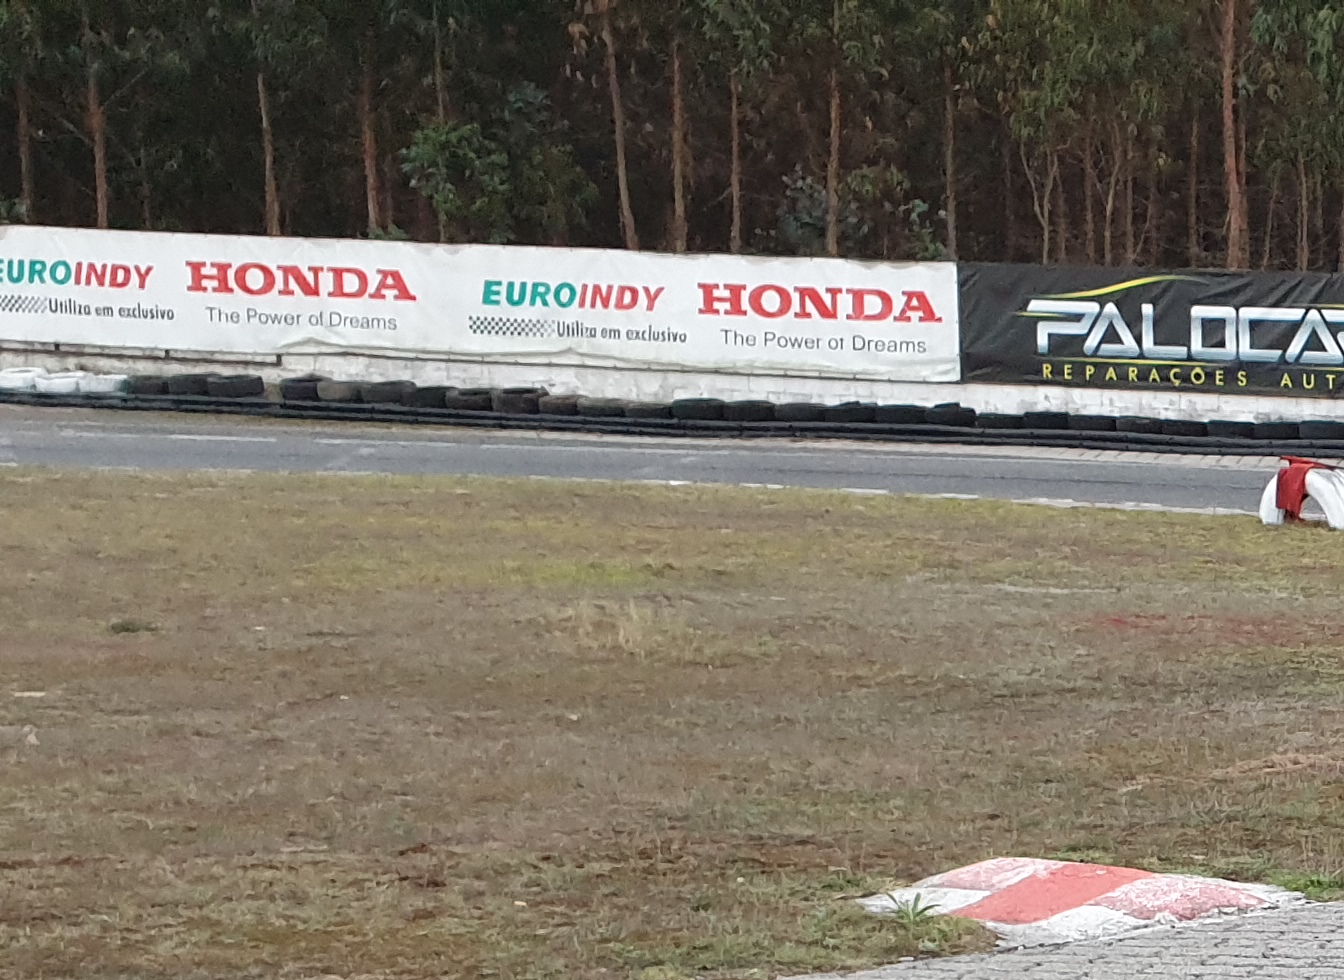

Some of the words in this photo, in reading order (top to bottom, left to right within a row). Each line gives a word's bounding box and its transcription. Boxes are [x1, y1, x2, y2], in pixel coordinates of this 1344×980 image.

[0, 258, 154, 291] UROINDY
[185, 260, 417, 302] HONDA
[481, 279, 665, 312] EUROINDY
[697, 282, 943, 324] HONDA
[49, 297, 91, 316] Utiliza
[95, 305, 114, 317] em
[118, 302, 175, 321] exclusivo
[205, 306, 240, 324] The
[246, 308, 302, 326] Power
[308, 311, 324, 327] of
[329, 311, 398, 331] Dreams
[556, 320, 597, 339] Utiliza
[601, 328, 621, 340] em
[626, 325, 688, 344] exclusivo
[720, 329, 757, 347] The
[764, 331, 821, 350] Power
[828, 336, 845, 351] of
[852, 334, 927, 353] Dreams
[1042, 362, 1248, 387] REPARAÇÕES
